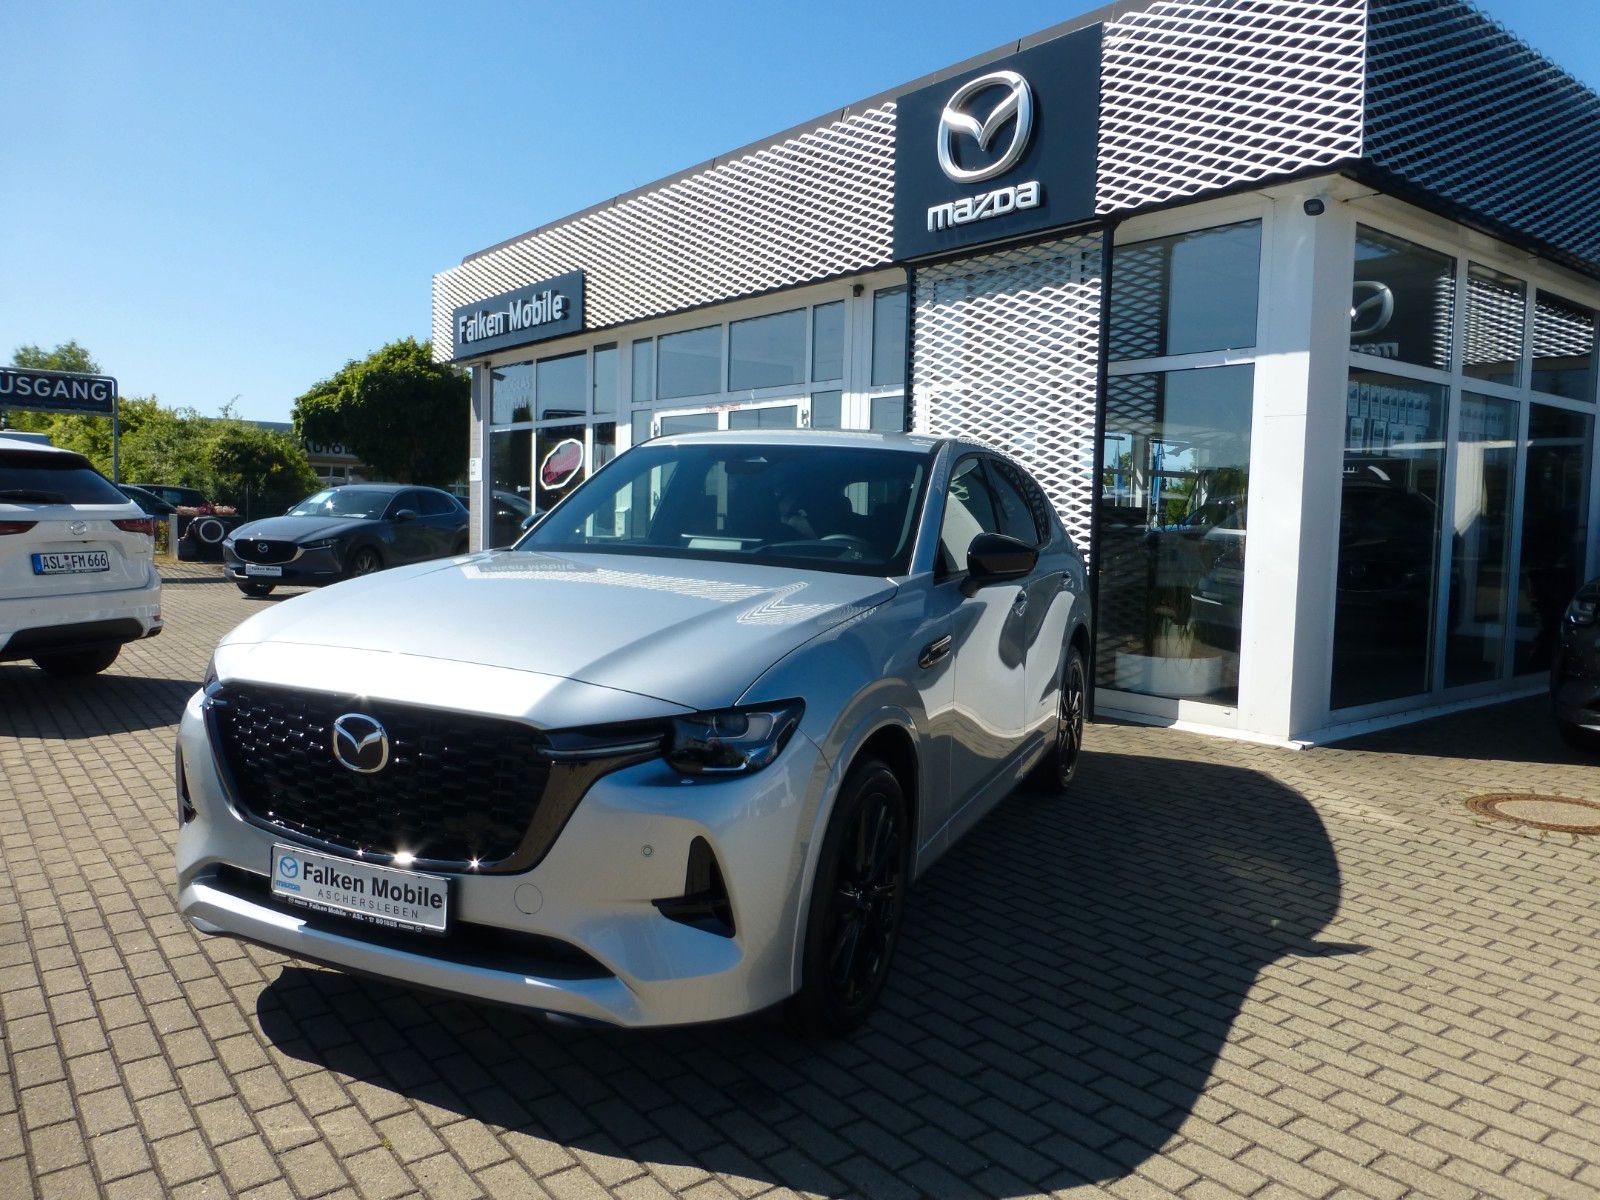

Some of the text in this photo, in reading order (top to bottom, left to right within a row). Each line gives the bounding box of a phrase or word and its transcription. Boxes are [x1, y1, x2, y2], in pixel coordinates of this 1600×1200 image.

[927, 180, 1041, 232] mazda
[459, 289, 564, 344] Falken Mobile
[0, 375, 107, 401] USGANG
[43, 553, 107, 570] ASL FM 666
[303, 861, 443, 909] Falken Mobile
[309, 902, 327, 912] Falken
[318, 888, 418, 919] ASCHERSLEBEN
